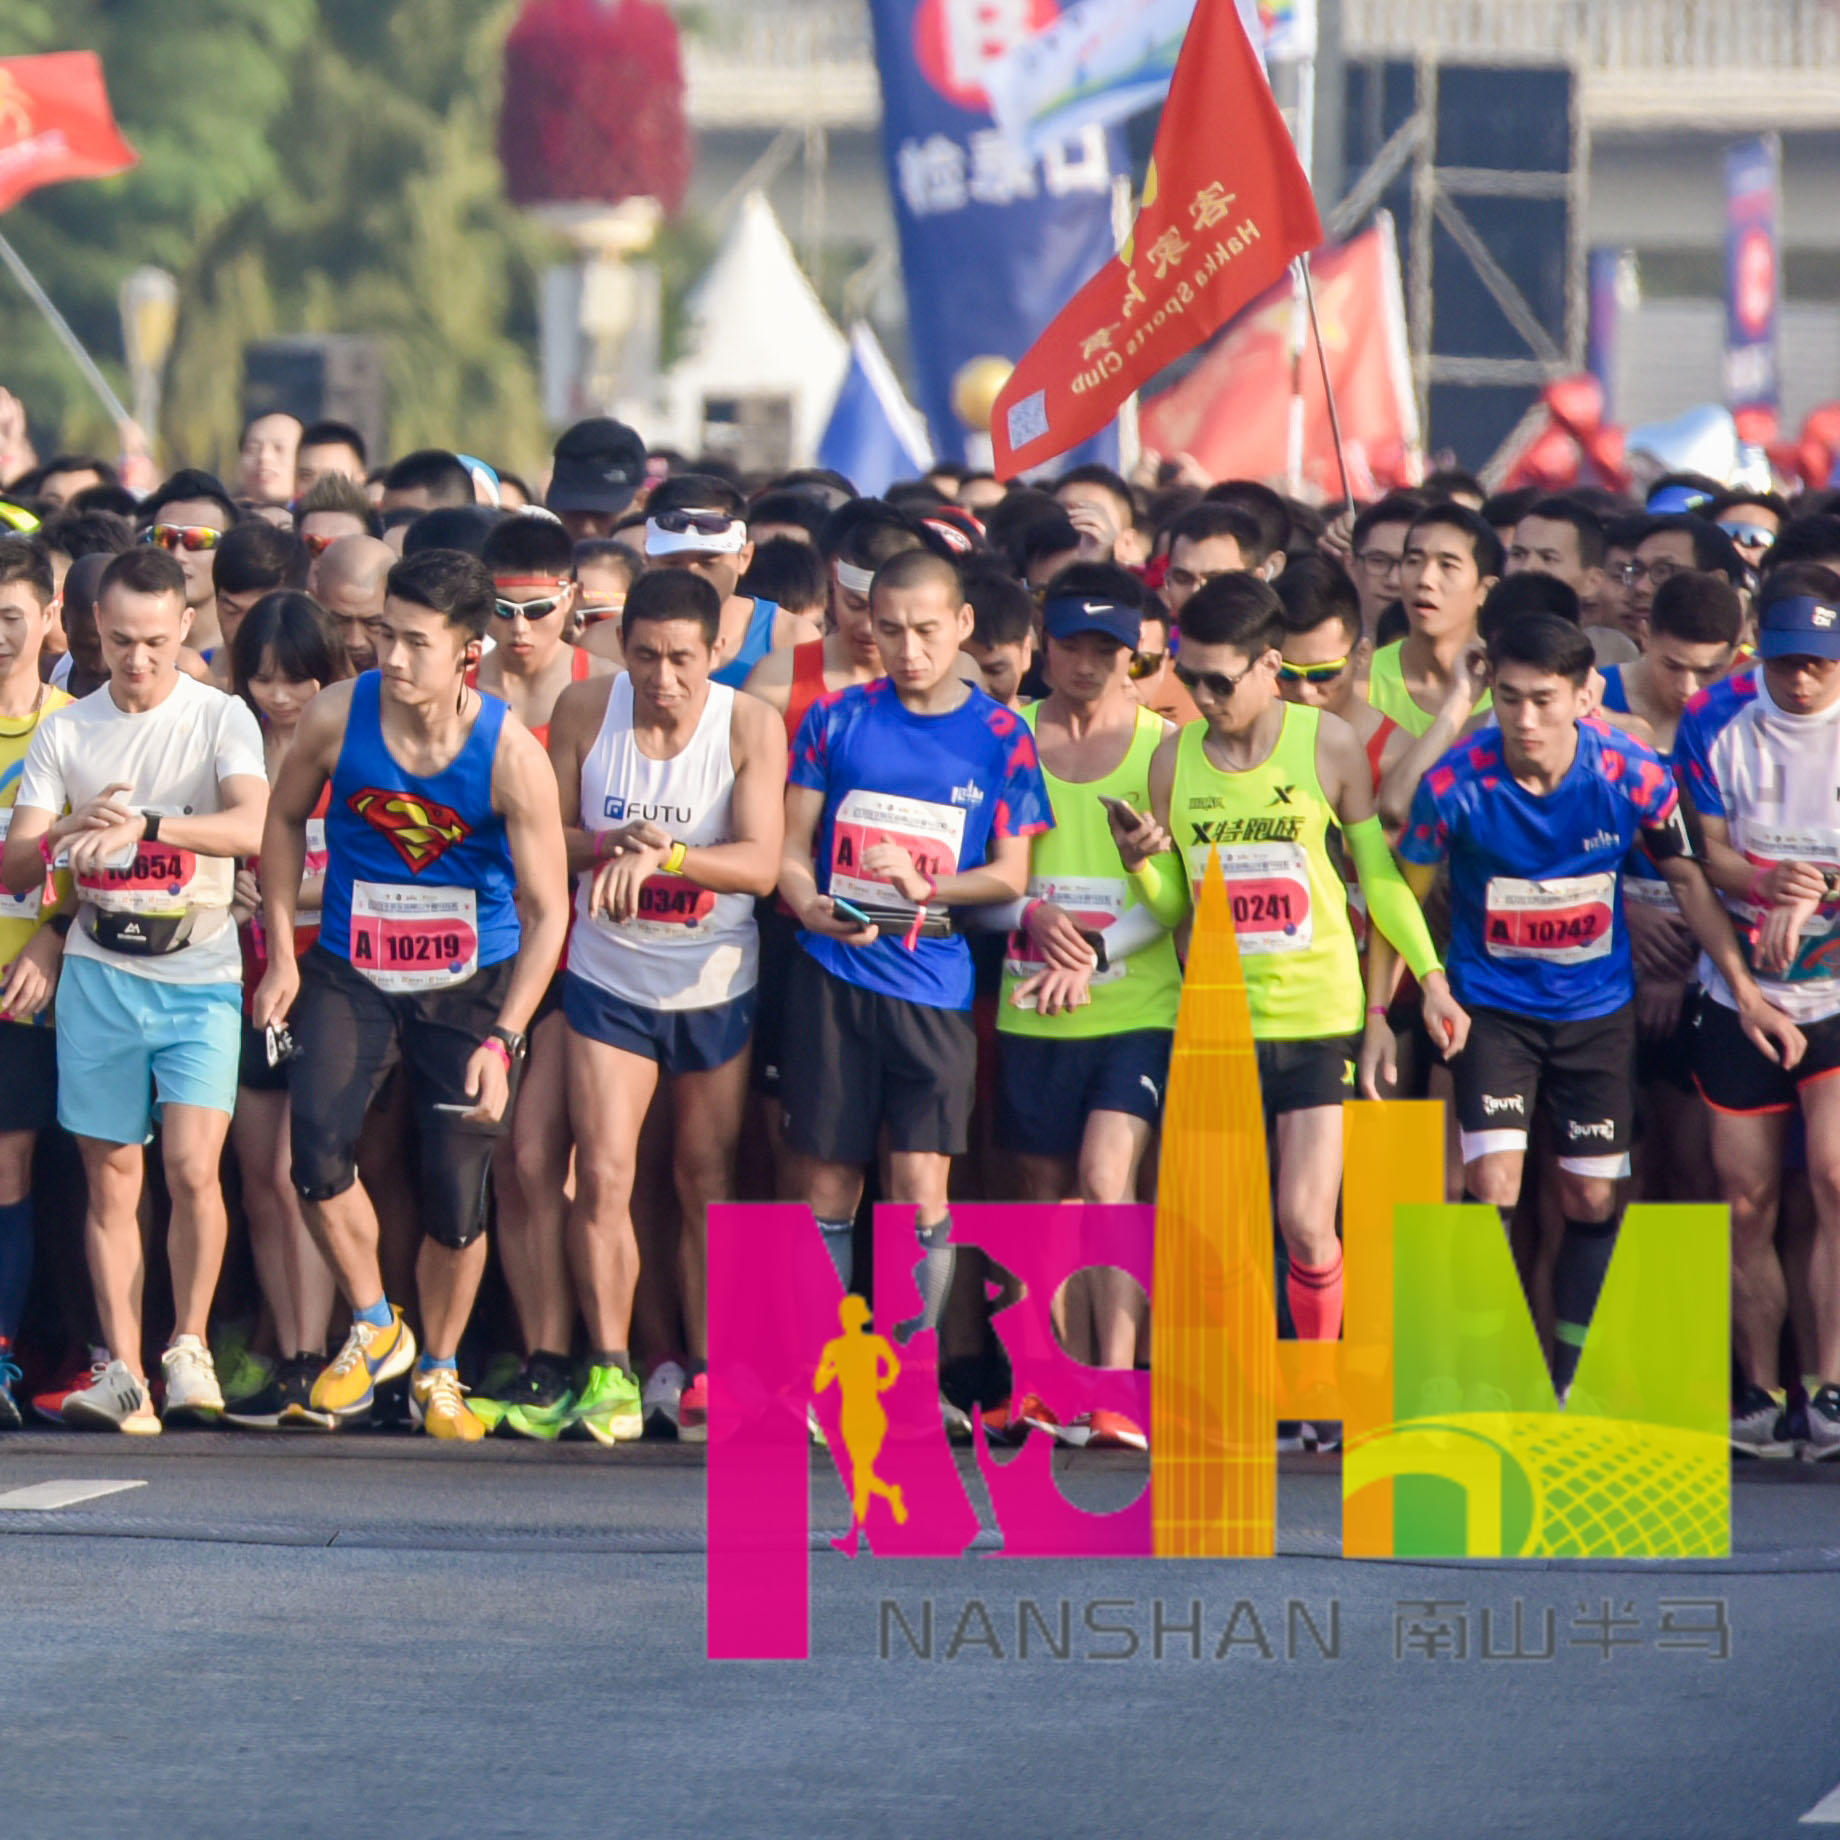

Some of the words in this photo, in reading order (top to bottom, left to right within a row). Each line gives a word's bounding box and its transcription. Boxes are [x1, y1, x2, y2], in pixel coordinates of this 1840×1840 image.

[626, 803, 691, 823] FUTU
[837, 836, 853, 867] A
[1233, 894, 1293, 923] 0241
[1528, 914, 1596, 941] 10742
[356, 930, 372, 960] A
[387, 933, 460, 960] 10219
